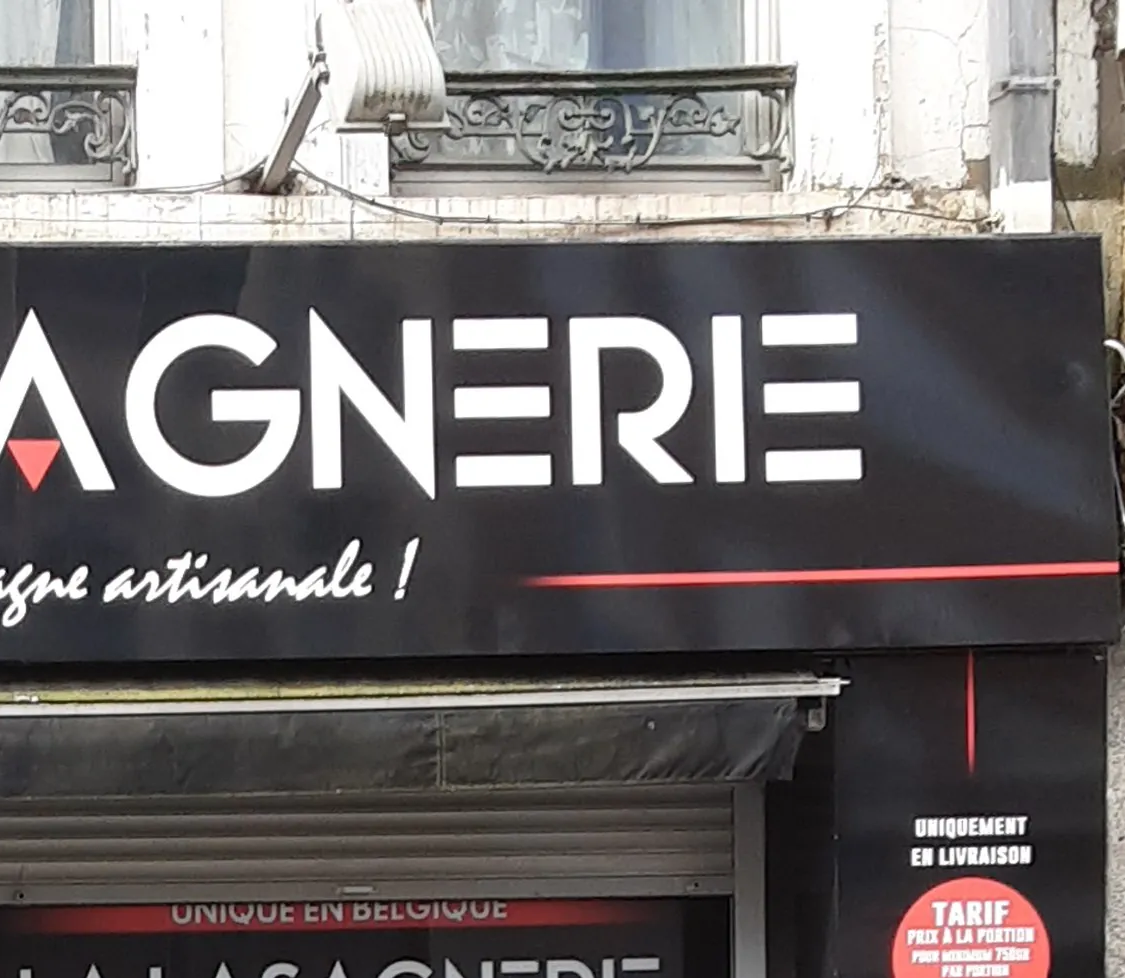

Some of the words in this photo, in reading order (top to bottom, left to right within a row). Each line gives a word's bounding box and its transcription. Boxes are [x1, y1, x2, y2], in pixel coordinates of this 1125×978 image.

[103, 538, 373, 604] artisanale
[394, 537, 421, 600] !
[915, 816, 1028, 840] UNIQUEMENT
[910, 848, 933, 867] EN
[938, 845, 1033, 866] LIVRAISON
[172, 902, 295, 924] UNIQUE
[304, 902, 344, 923] EN
[353, 901, 508, 922] BELGIQUE
[931, 900, 1011, 927] TARIF
[907, 929, 939, 945] PRIX
[956, 928, 973, 944] LA
[977, 927, 1035, 943] PORTION
